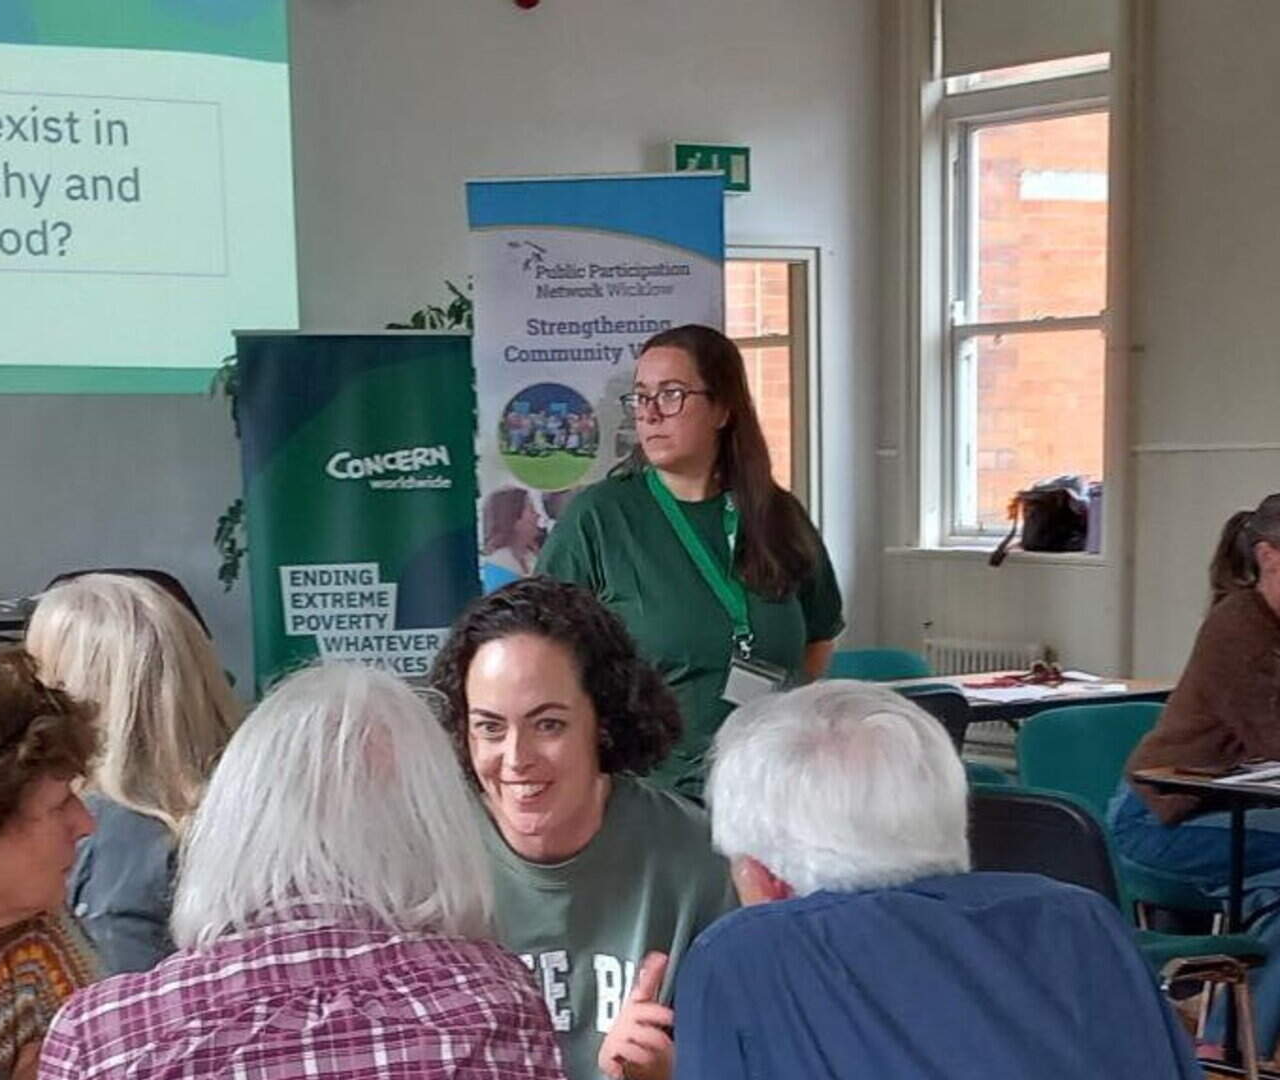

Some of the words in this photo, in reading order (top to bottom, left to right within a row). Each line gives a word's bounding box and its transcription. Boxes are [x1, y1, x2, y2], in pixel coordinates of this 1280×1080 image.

[93, 108, 129, 147] in
[65, 166, 141, 203] and
[535, 263, 586, 279] Public
[588, 262, 690, 281] Participation
[535, 284, 604, 299] Network
[606, 282, 675, 298] Wicklow
[504, 343, 622, 365] Community
[326, 446, 451, 479] CONCERN
[370, 476, 452, 489] worldwide
[289, 569, 373, 587] ENDING
[290, 591, 390, 609] EXTREME
[291, 613, 388, 632] POVERTY
[322, 634, 440, 652] WHATEVER
